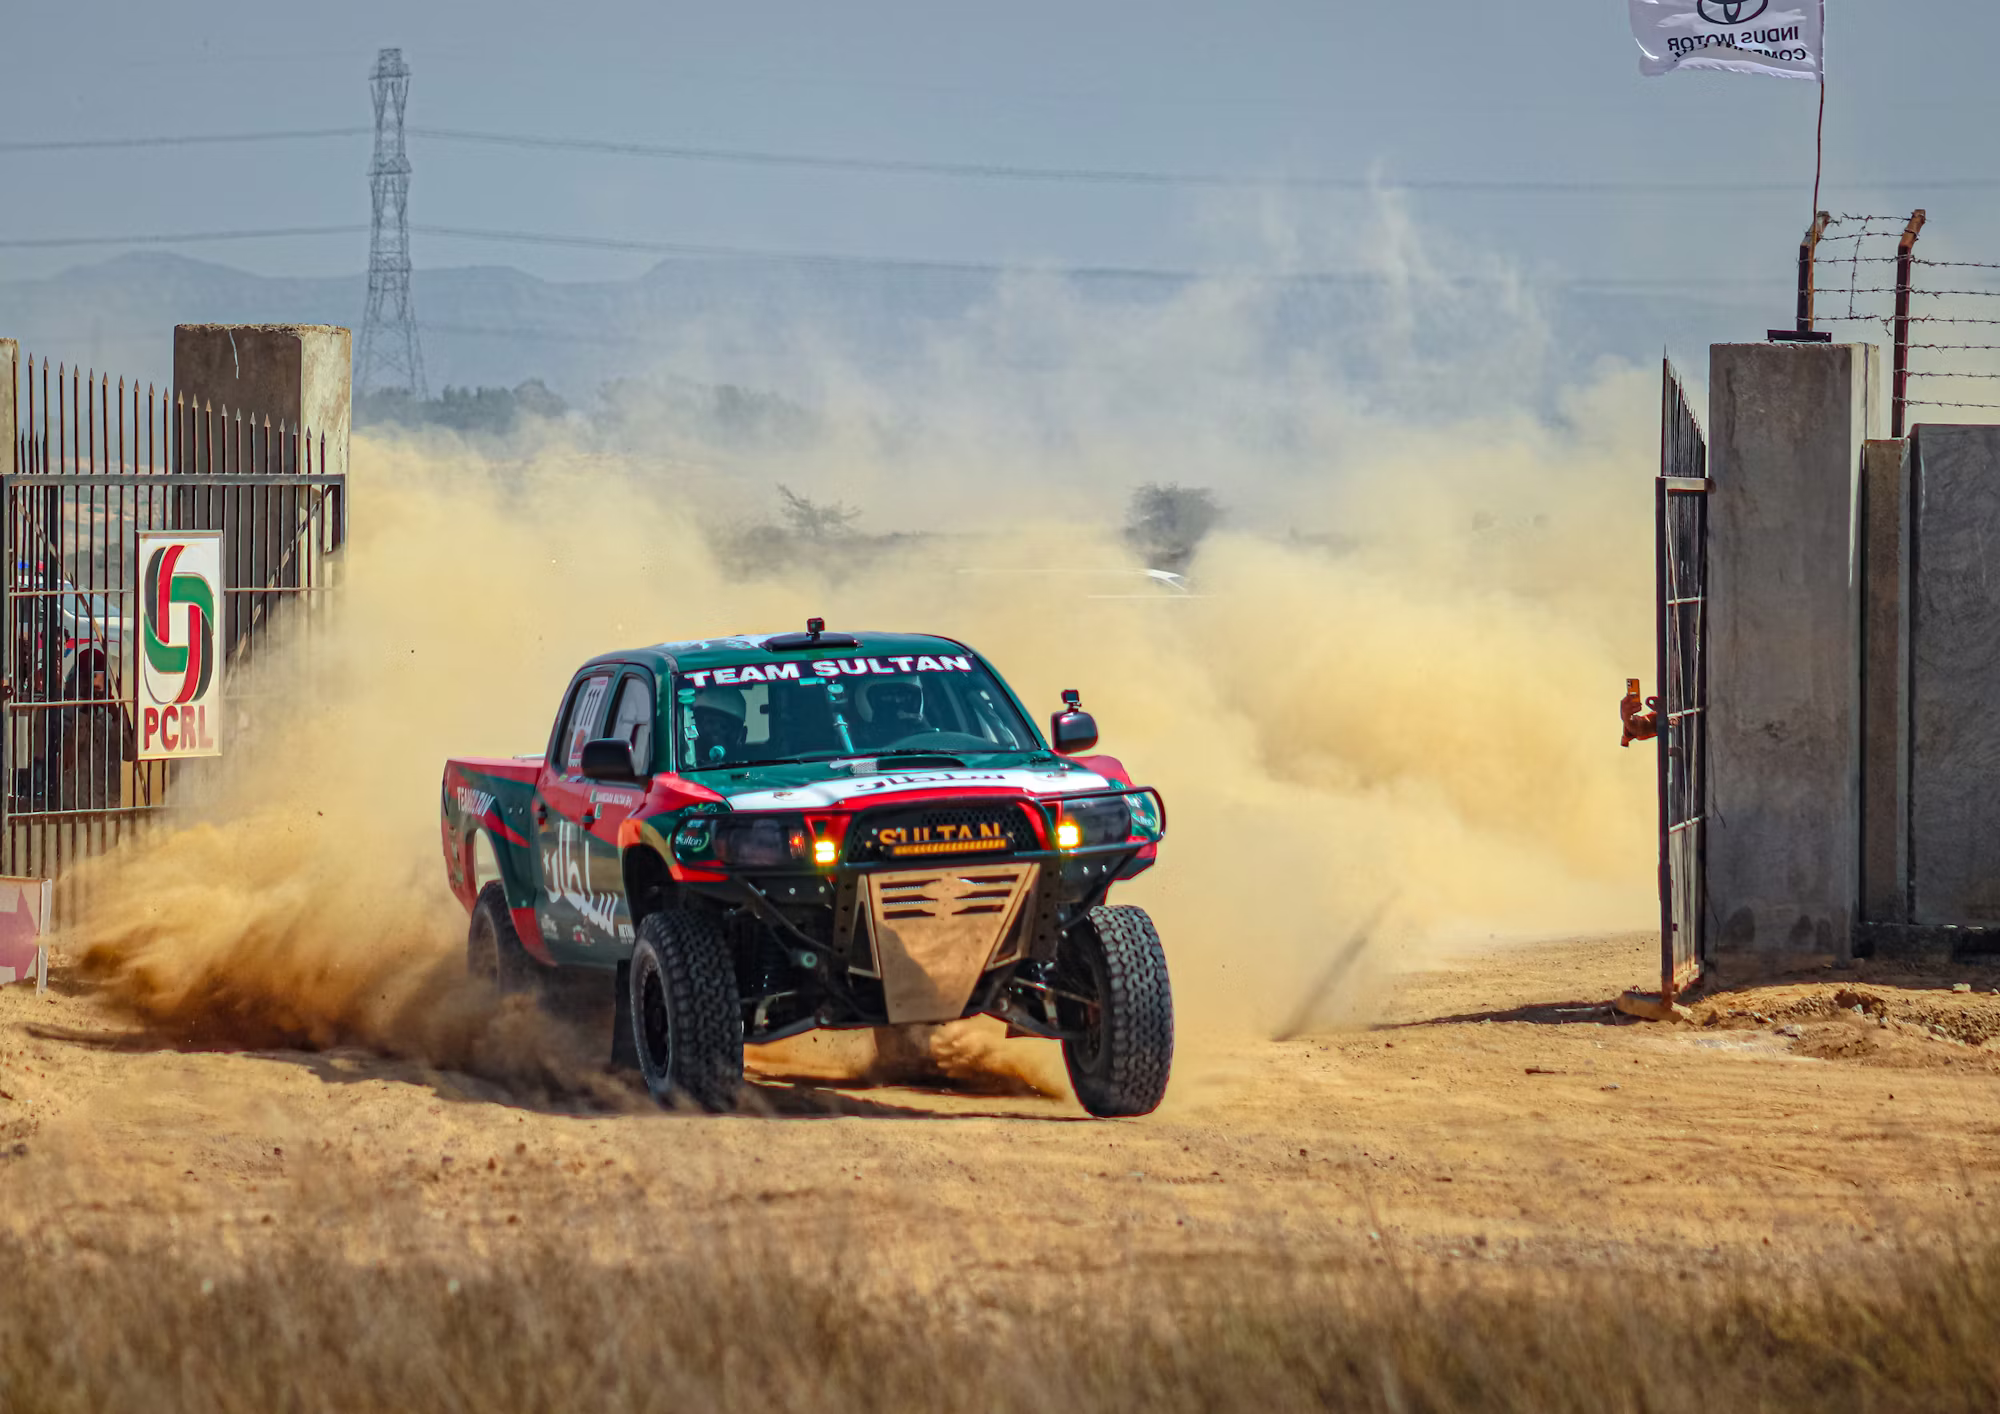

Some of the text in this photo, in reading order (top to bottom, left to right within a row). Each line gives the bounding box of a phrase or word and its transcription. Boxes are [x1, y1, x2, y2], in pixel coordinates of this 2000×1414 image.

[684, 655, 972, 688] TEAM SULTAN
[143, 704, 214, 752] PCRL
